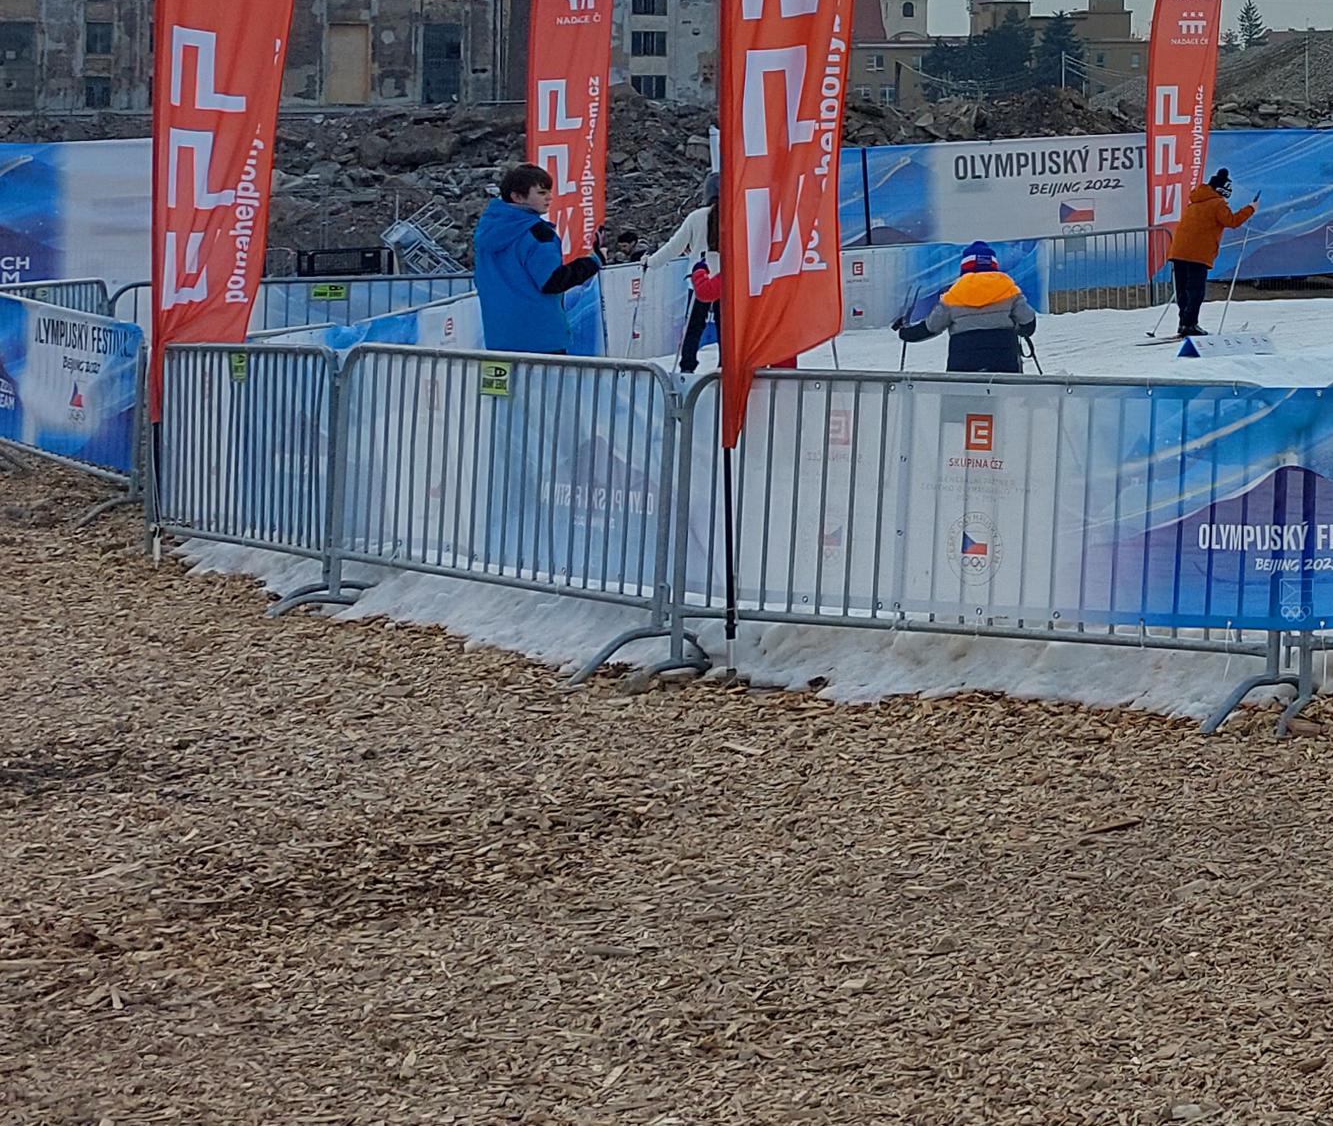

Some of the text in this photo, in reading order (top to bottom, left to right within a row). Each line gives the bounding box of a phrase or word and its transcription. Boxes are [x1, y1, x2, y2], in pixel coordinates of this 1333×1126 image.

[954, 144, 1146, 181] OLYMPIJSKÝ FEST
[1029, 177, 1126, 197] BEIJING 2022
[949, 457, 1004, 471] SKUPINA ČEZ
[1199, 521, 1308, 551] OLYMPIJSKÝ
[1255, 557, 1300, 573] BEIJING
